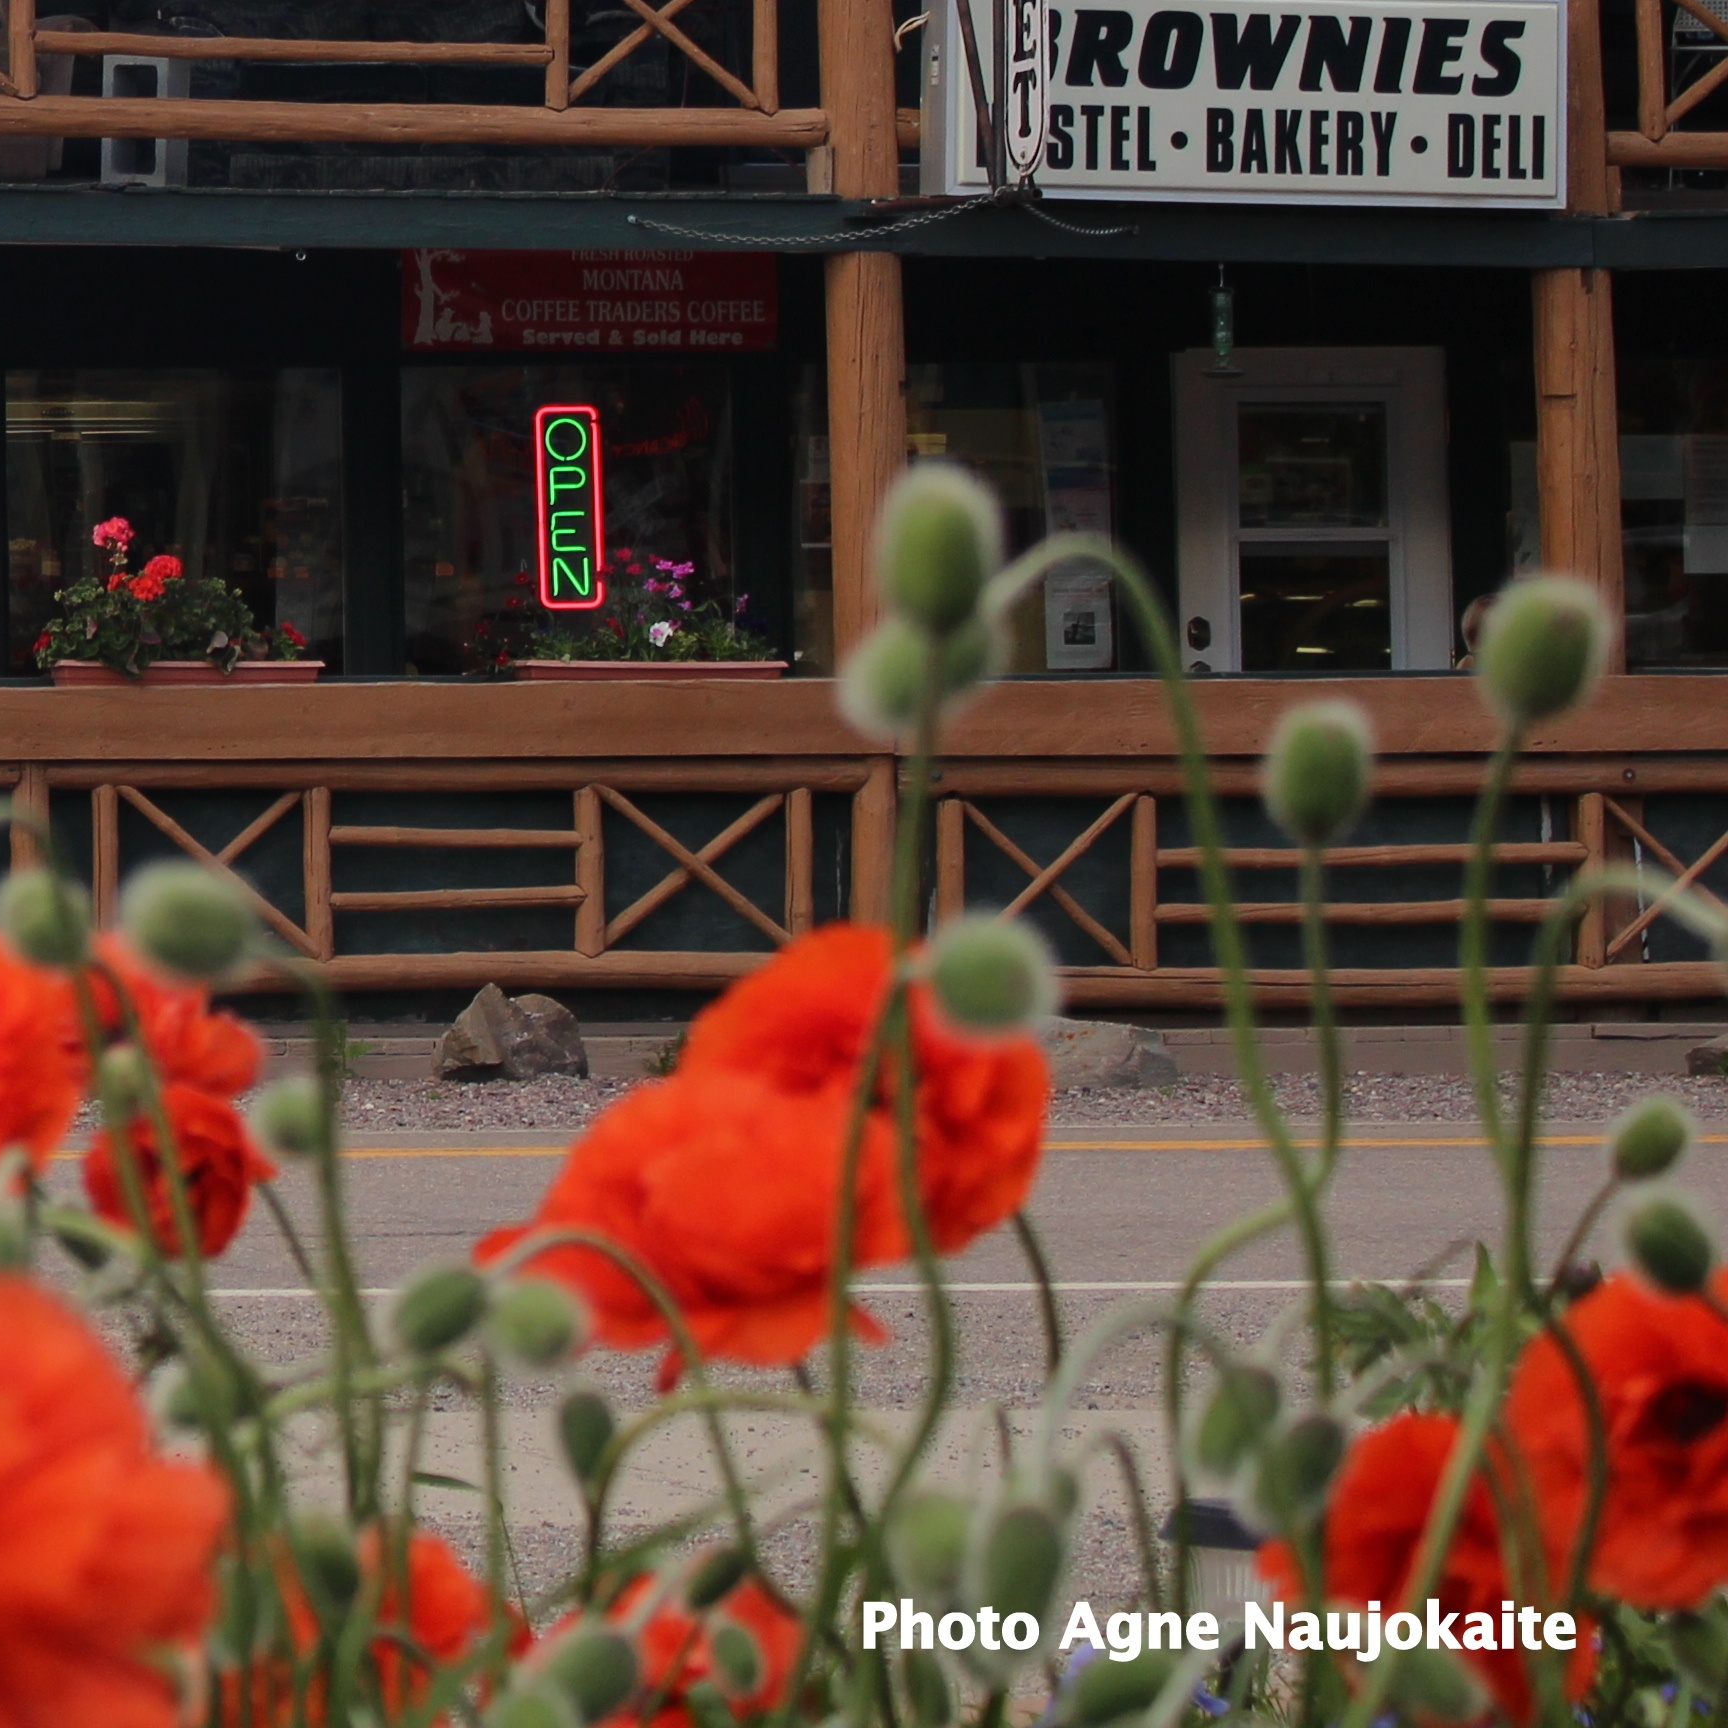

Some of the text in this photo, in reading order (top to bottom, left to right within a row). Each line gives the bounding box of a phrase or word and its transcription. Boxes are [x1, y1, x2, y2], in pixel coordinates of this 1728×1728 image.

[976, 104, 1546, 182] STEL BAKERY DELI
[582, 269, 685, 292] MONTANA
[501, 300, 766, 323] COFFEE TRADERS COFFEE
[522, 328, 743, 346] Served & Sold Here
[545, 418, 590, 597] OPEN
